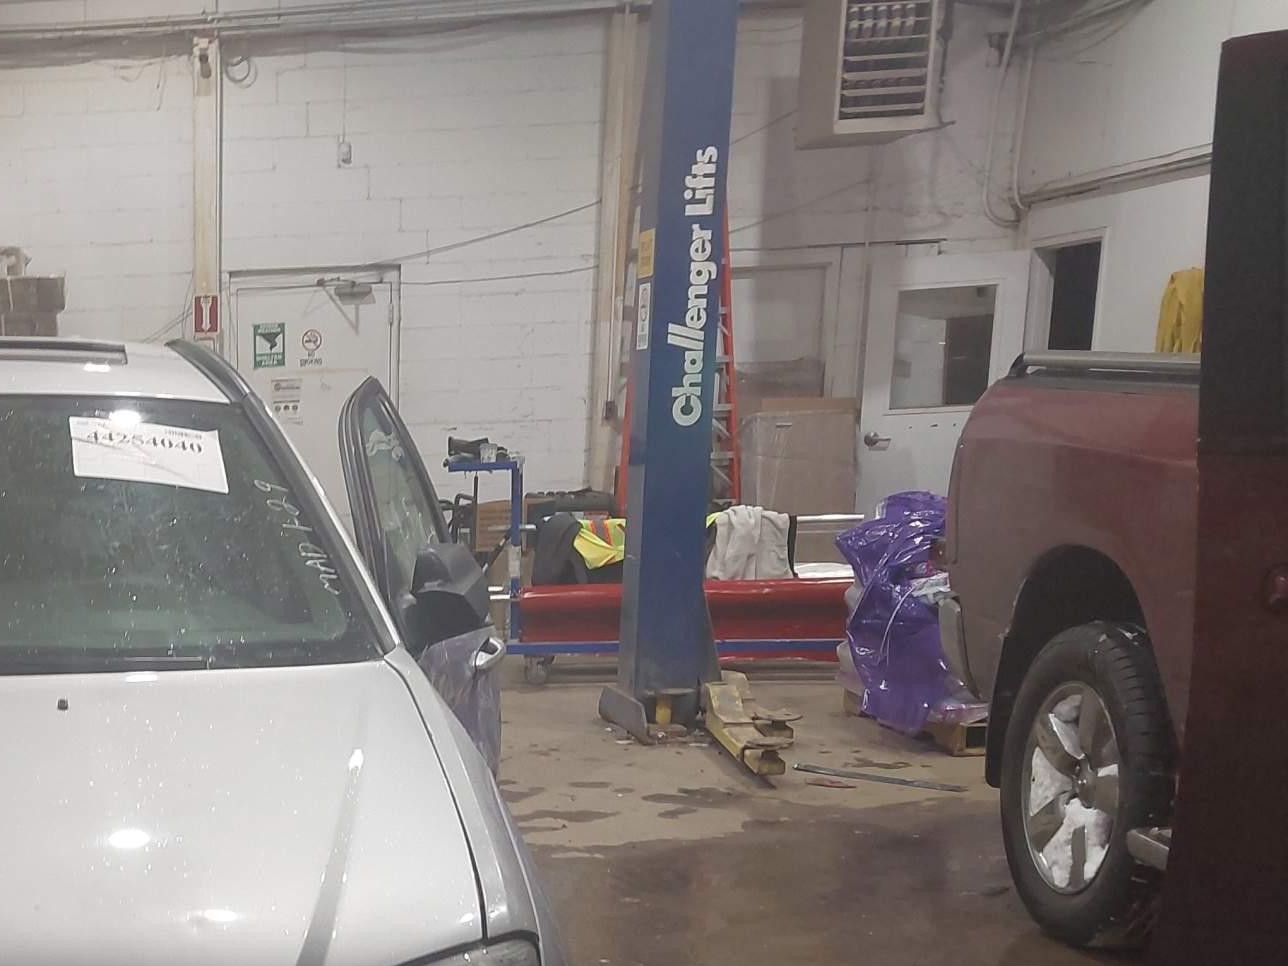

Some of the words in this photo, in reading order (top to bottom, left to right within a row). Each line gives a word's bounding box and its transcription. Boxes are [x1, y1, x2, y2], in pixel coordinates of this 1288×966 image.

[684, 145, 718, 217] Lifts
[667, 223, 717, 427] Challenger
[87, 429, 203, 453] 44254040
